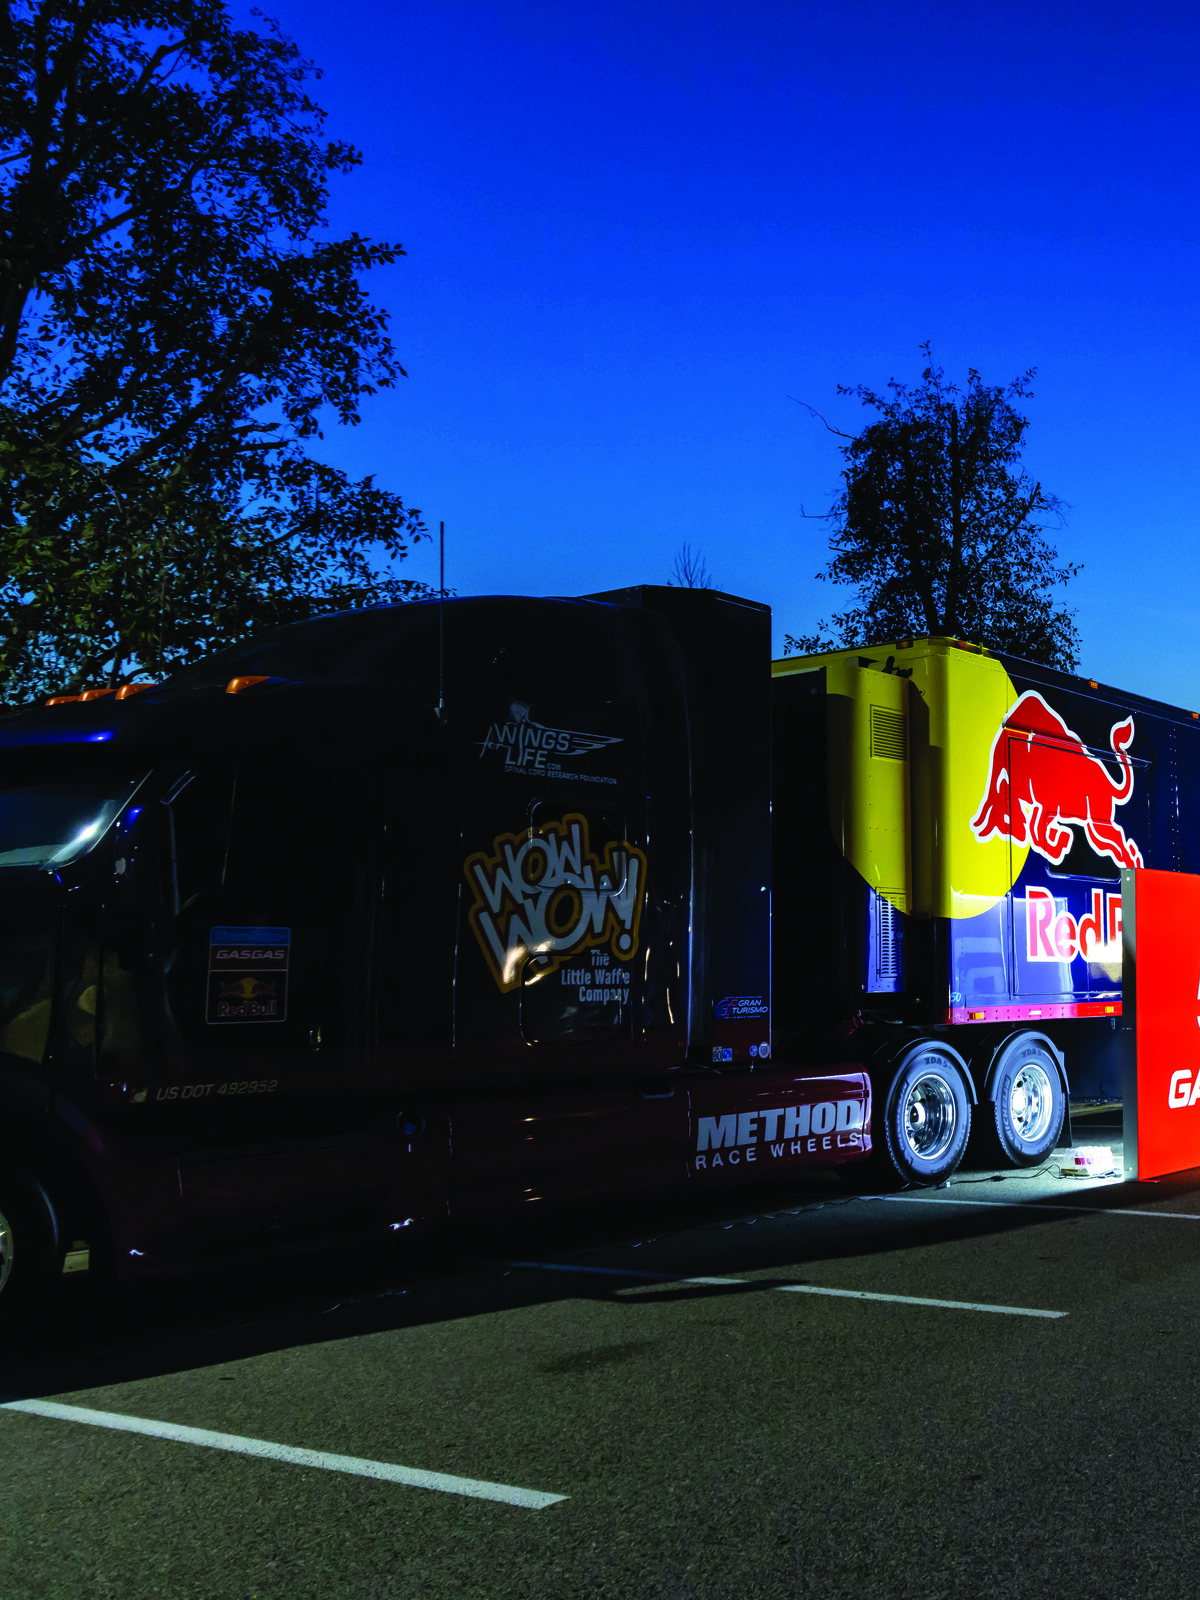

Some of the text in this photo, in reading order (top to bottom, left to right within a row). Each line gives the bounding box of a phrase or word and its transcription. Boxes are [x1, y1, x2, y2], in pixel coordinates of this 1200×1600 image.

[493, 718, 571, 751] WINGS
[505, 747, 549, 769] LIFE
[505, 765, 617, 785] SPINAL CORD RESEARCH FOUNDATION
[469, 819, 585, 915] WOW
[476, 850, 640, 985] WOW!
[216, 949, 285, 960] GASGAS
[590, 948, 610, 967] The
[561, 968, 592, 986] Little
[578, 986, 630, 1006] Company
[738, 999, 762, 1007] GRAN
[732, 1006, 769, 1015] TURISMO
[156, 1079, 279, 1101] US DOT 492952
[696, 1099, 864, 1152] METHOD
[695, 1132, 860, 1170] RACE WHEELS
